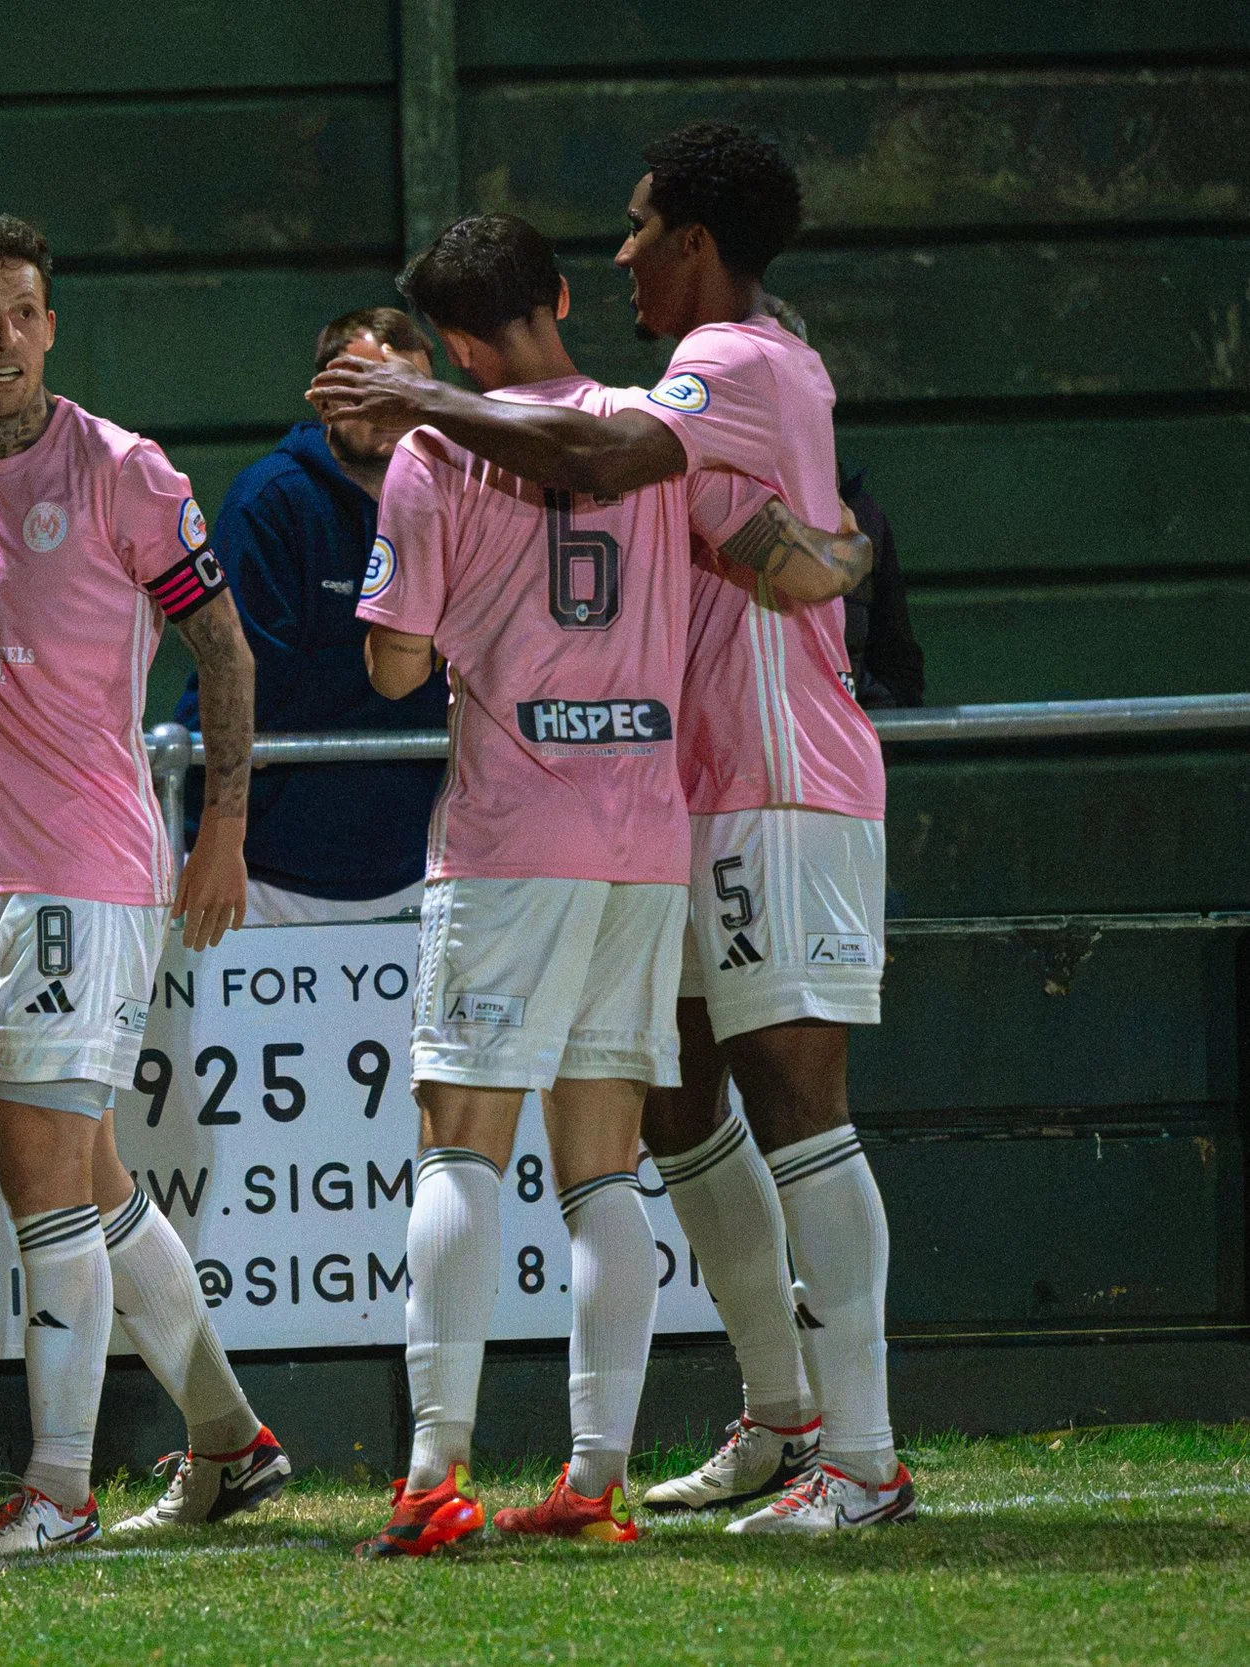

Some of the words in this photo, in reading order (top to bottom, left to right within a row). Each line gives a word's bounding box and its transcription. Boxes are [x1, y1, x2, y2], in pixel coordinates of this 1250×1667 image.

[195, 551, 223, 588] C
[713, 855, 753, 931] 5
[37, 905, 74, 978] 8
[222, 966, 318, 1007] FOR
